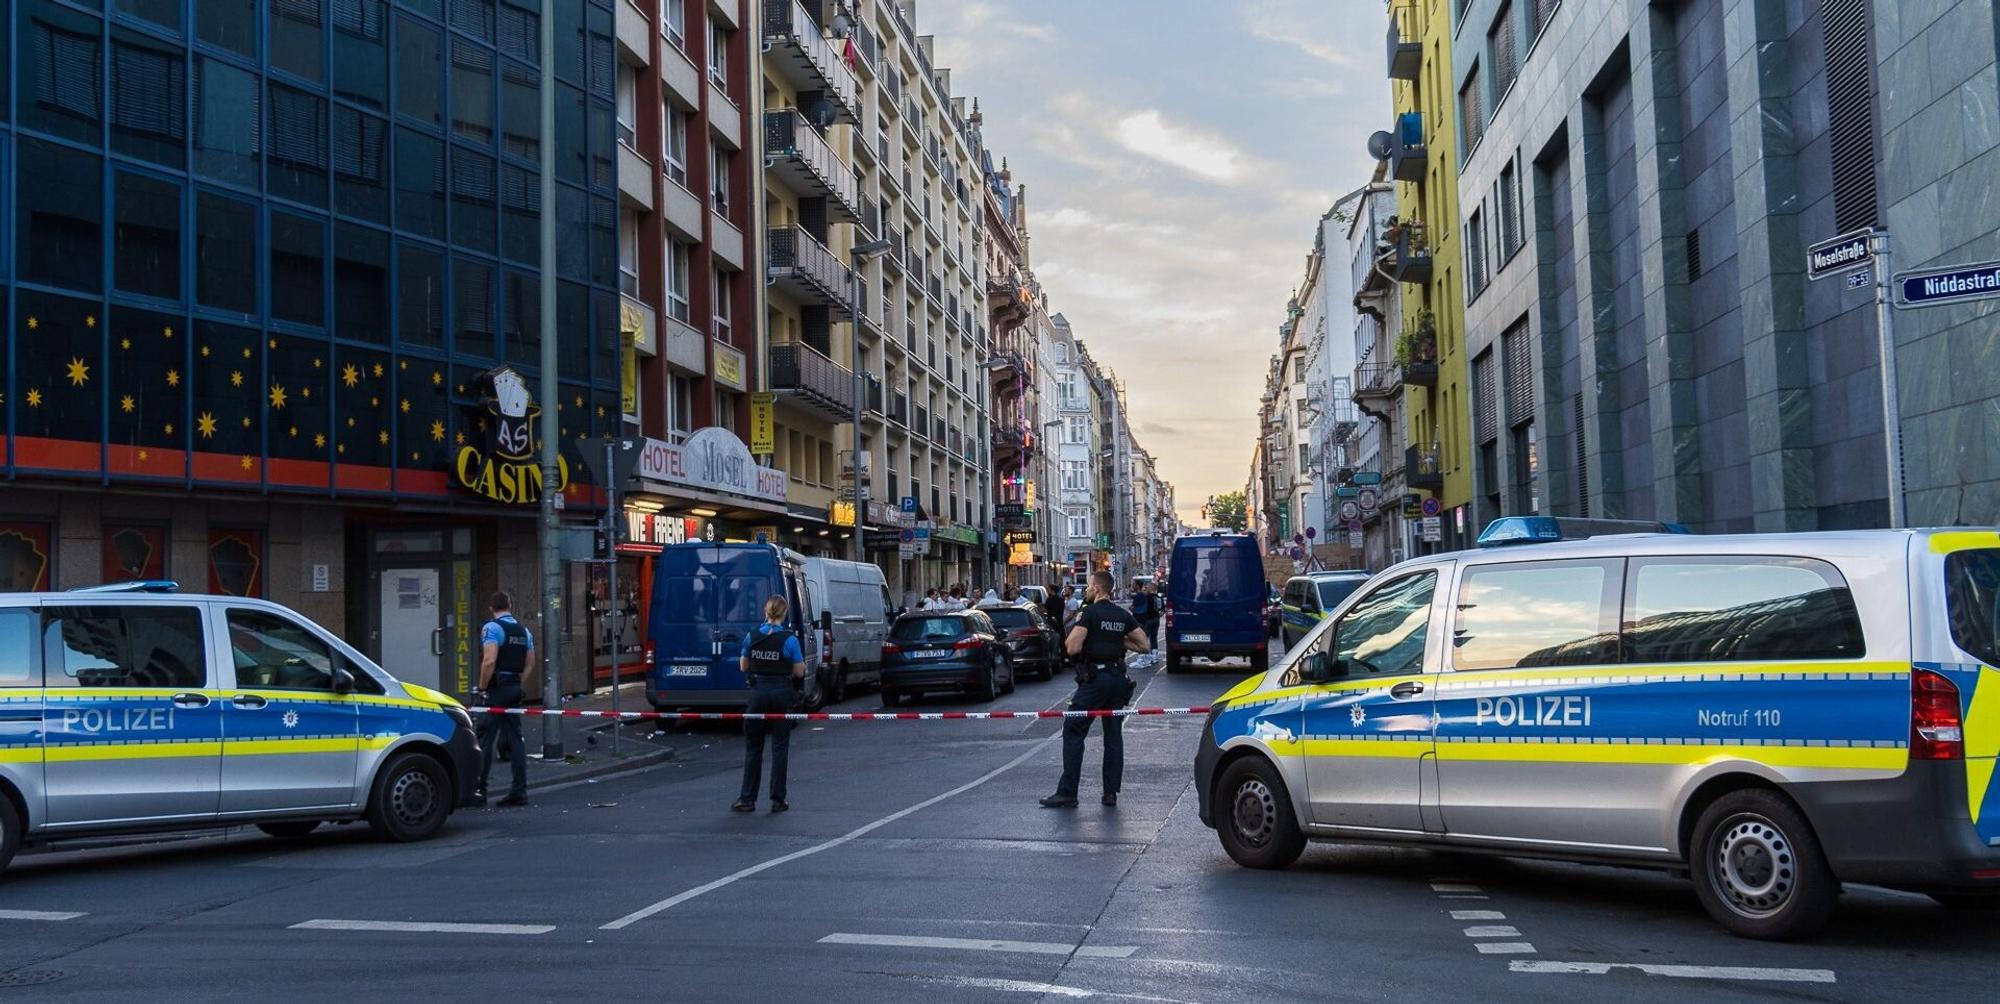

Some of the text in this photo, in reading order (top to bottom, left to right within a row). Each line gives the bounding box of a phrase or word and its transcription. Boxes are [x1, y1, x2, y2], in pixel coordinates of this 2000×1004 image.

[1814, 242, 1865, 269] Moselstraße
[498, 419, 528, 454] AS
[643, 439, 786, 498] HOTEL MOSEL HOTEL
[904, 500, 914, 511] P
[997, 505, 1021, 513] HOTEL
[1011, 532, 1033, 540] HOTEL
[1100, 621, 1126, 632] POLIZEI
[751, 650, 780, 661] POLIZEI
[63, 707, 175, 733] POLIZEI
[1476, 697, 1591, 727] POLIZEI
[1698, 709, 1781, 727] Notruf 110
